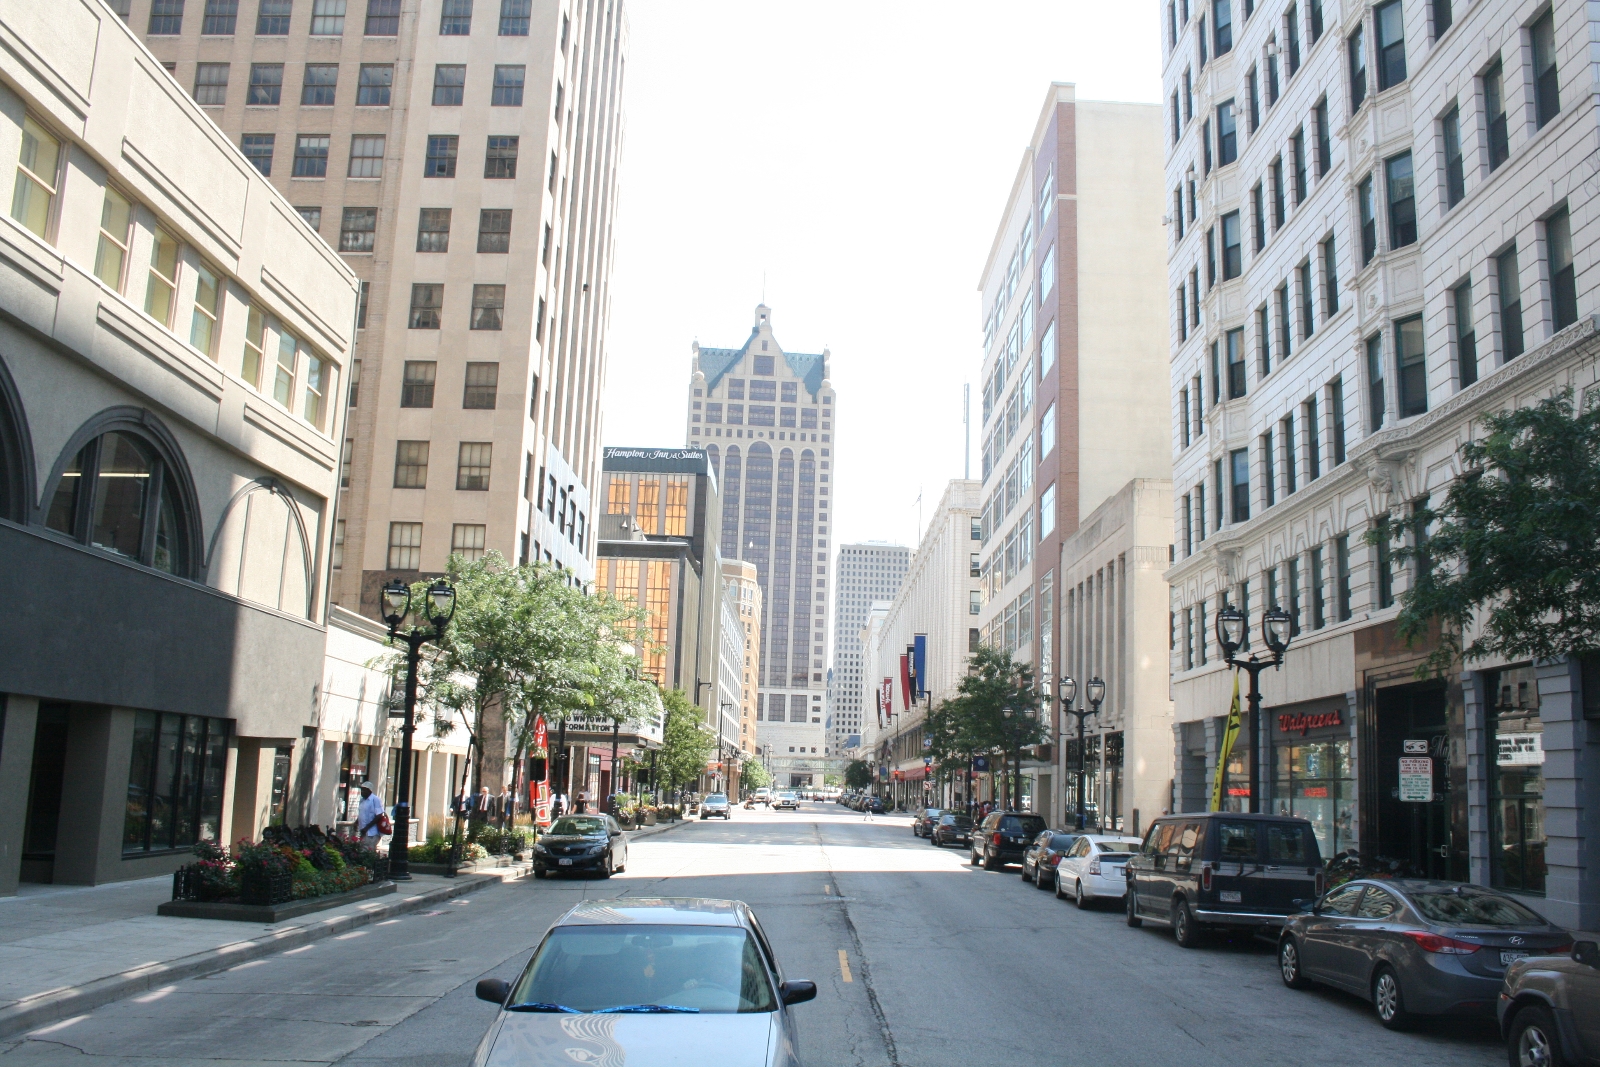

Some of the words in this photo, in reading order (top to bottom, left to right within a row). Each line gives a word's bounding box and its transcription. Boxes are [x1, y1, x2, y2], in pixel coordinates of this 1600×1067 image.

[603, 448, 648, 458] Hampton
[649, 449, 673, 459] Inn
[678, 450, 702, 459] Suites
[1278, 709, 1342, 736] Walgreens
